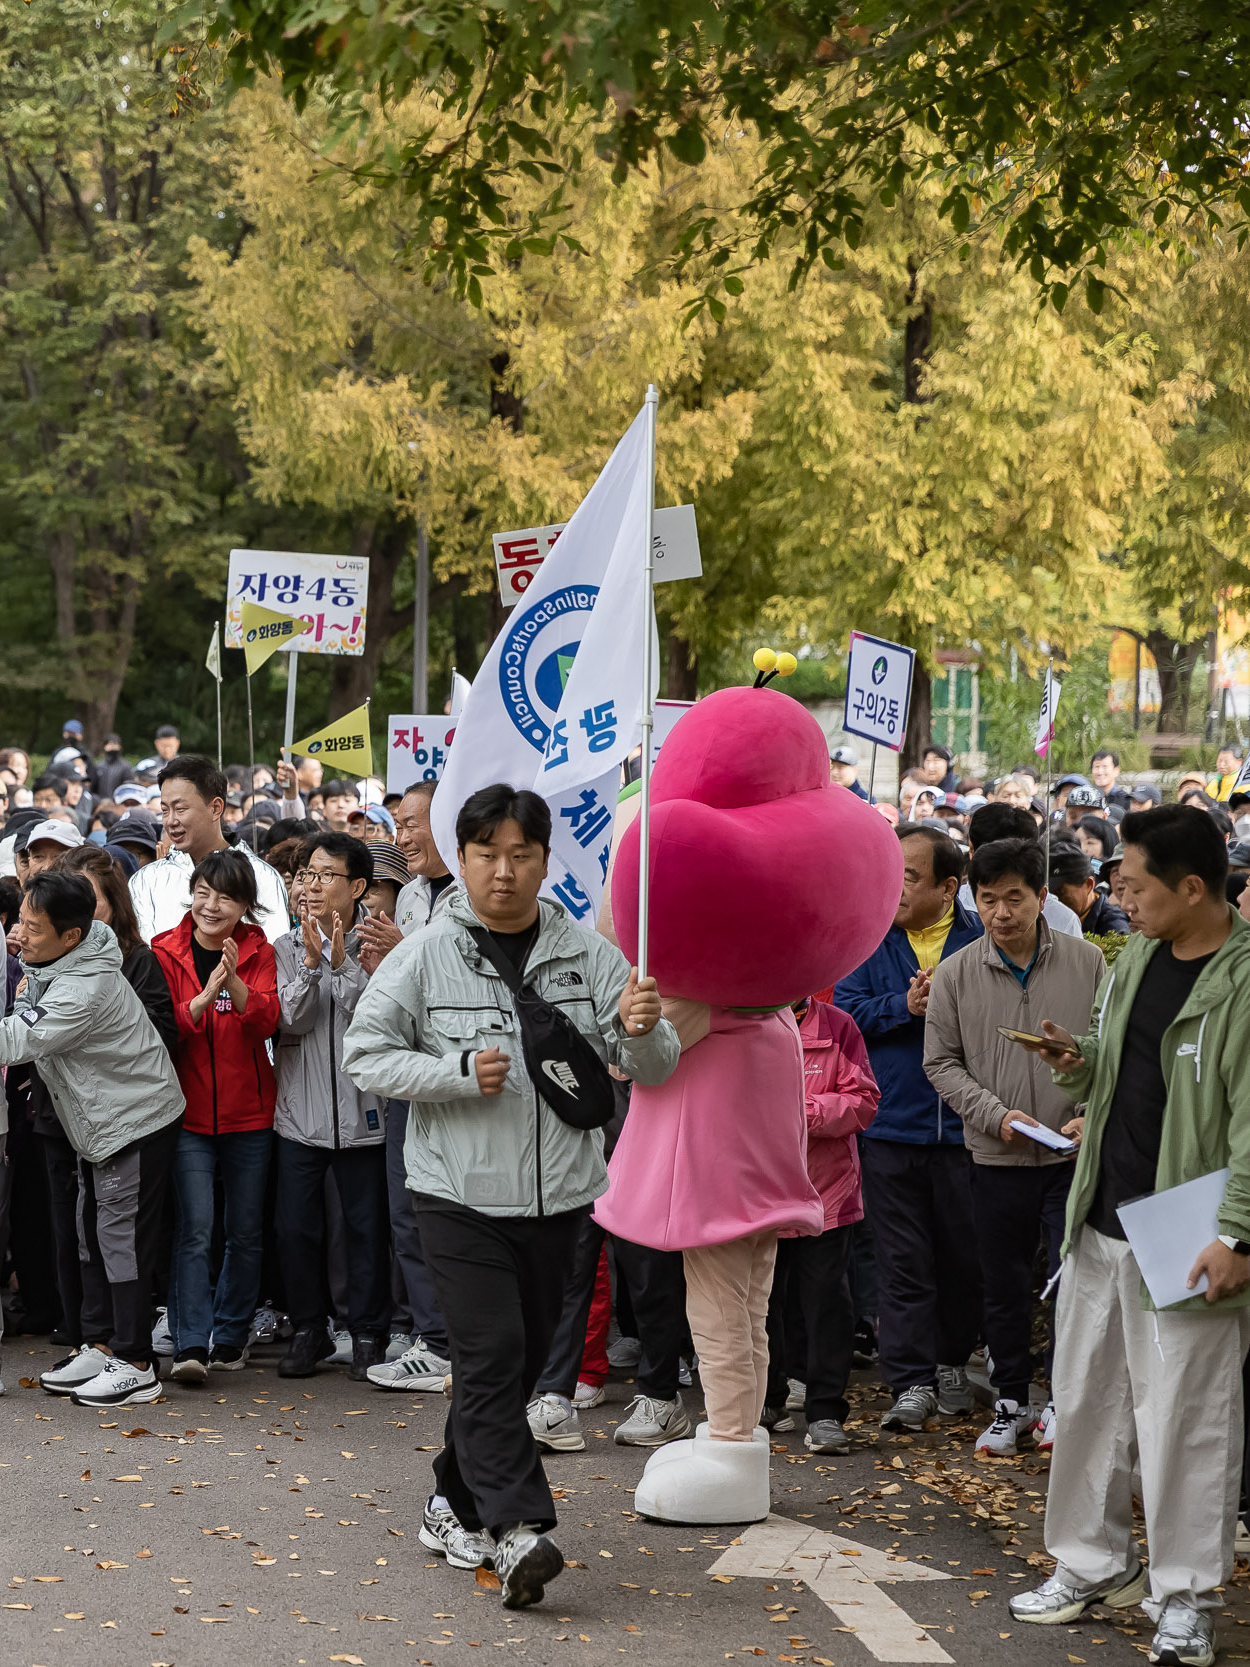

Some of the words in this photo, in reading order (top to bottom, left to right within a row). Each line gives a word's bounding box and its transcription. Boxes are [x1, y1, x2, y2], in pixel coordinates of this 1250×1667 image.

[236, 572, 359, 607] 자양4동
[258, 620, 294, 640] 화양동
[853, 687, 899, 735] 구의2동
[324, 734, 365, 752] 화양동
[553, 1061, 580, 1091] NIKE
[112, 1377, 139, 1391] HOKA
